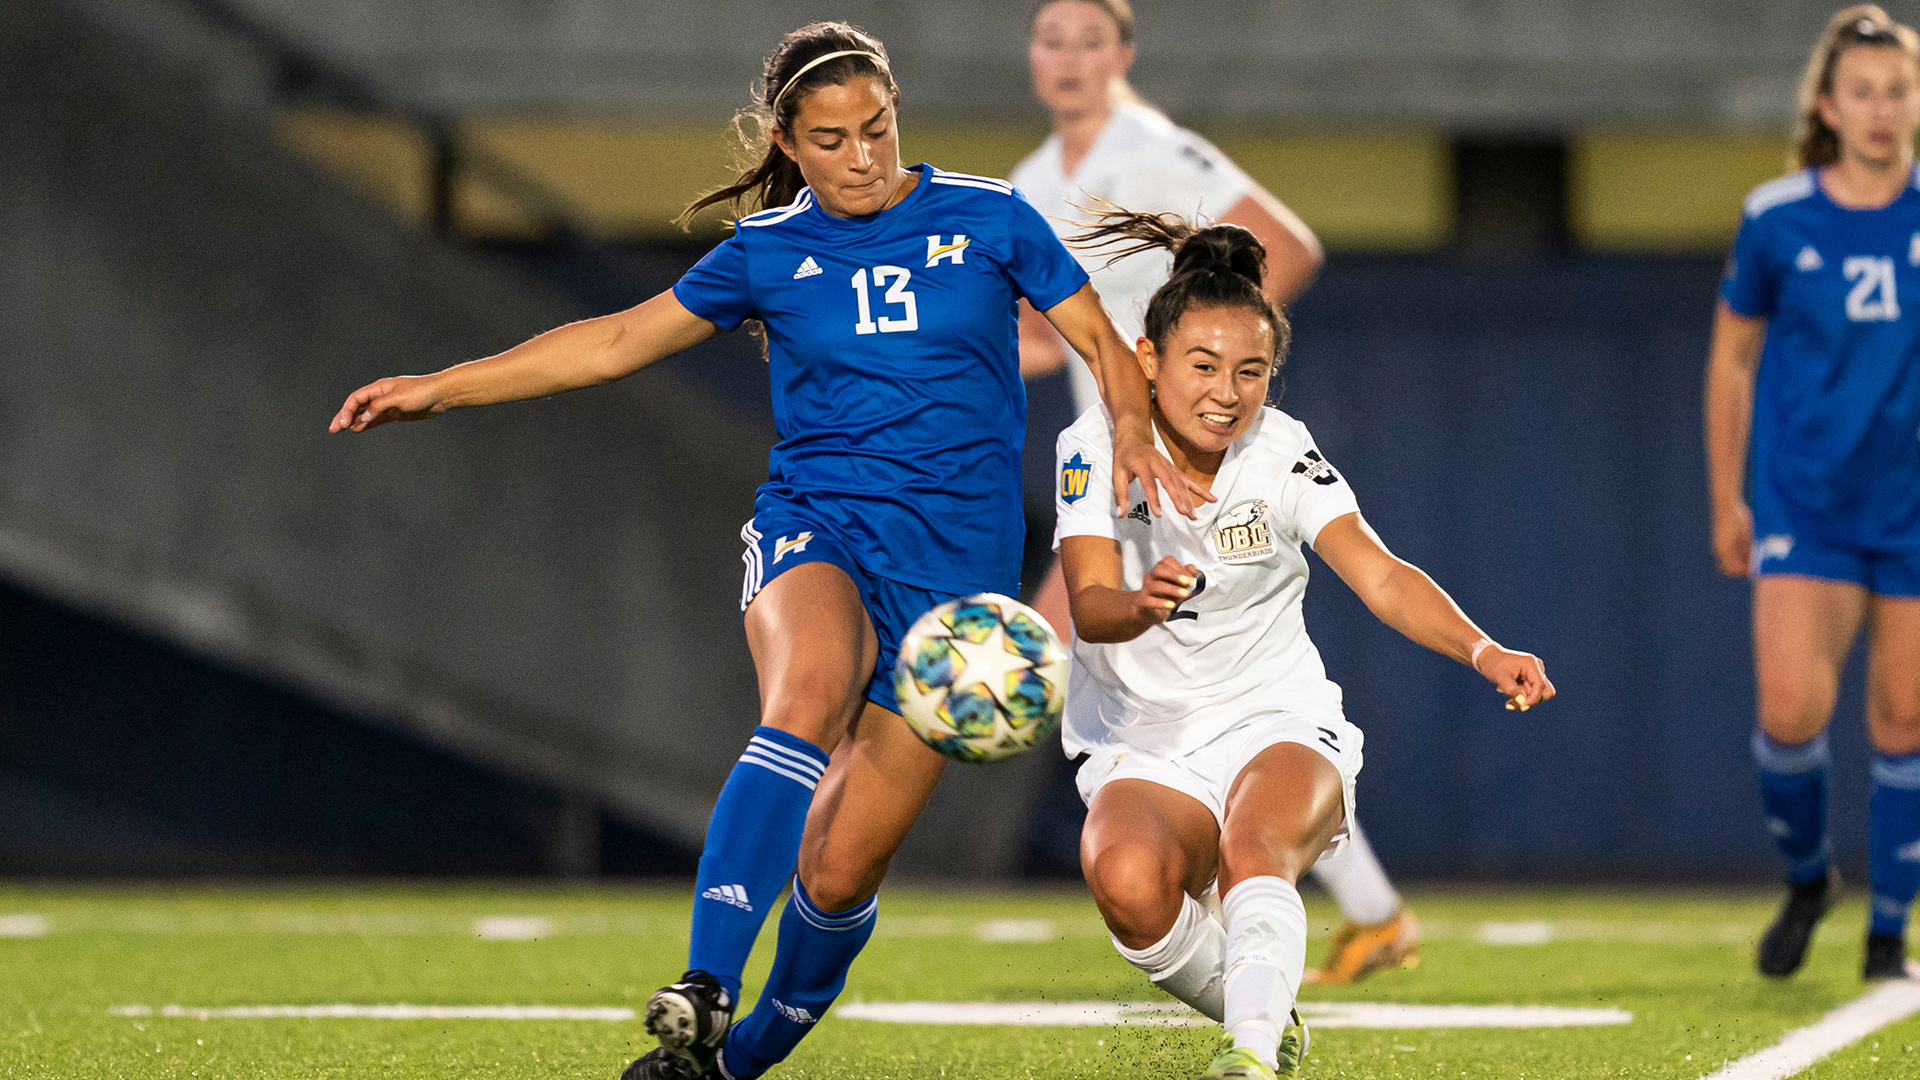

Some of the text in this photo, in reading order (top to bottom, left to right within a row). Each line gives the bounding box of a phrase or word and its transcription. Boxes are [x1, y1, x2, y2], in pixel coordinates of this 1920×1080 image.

[794, 267, 823, 279] adidas
[851, 265, 918, 334] 13
[1843, 256, 1900, 322] 21
[1061, 469, 1088, 496] CW
[1213, 522, 1271, 553] UBC
[1218, 547, 1273, 561] THUNDERBIRDS
[702, 890, 753, 912] adidas
